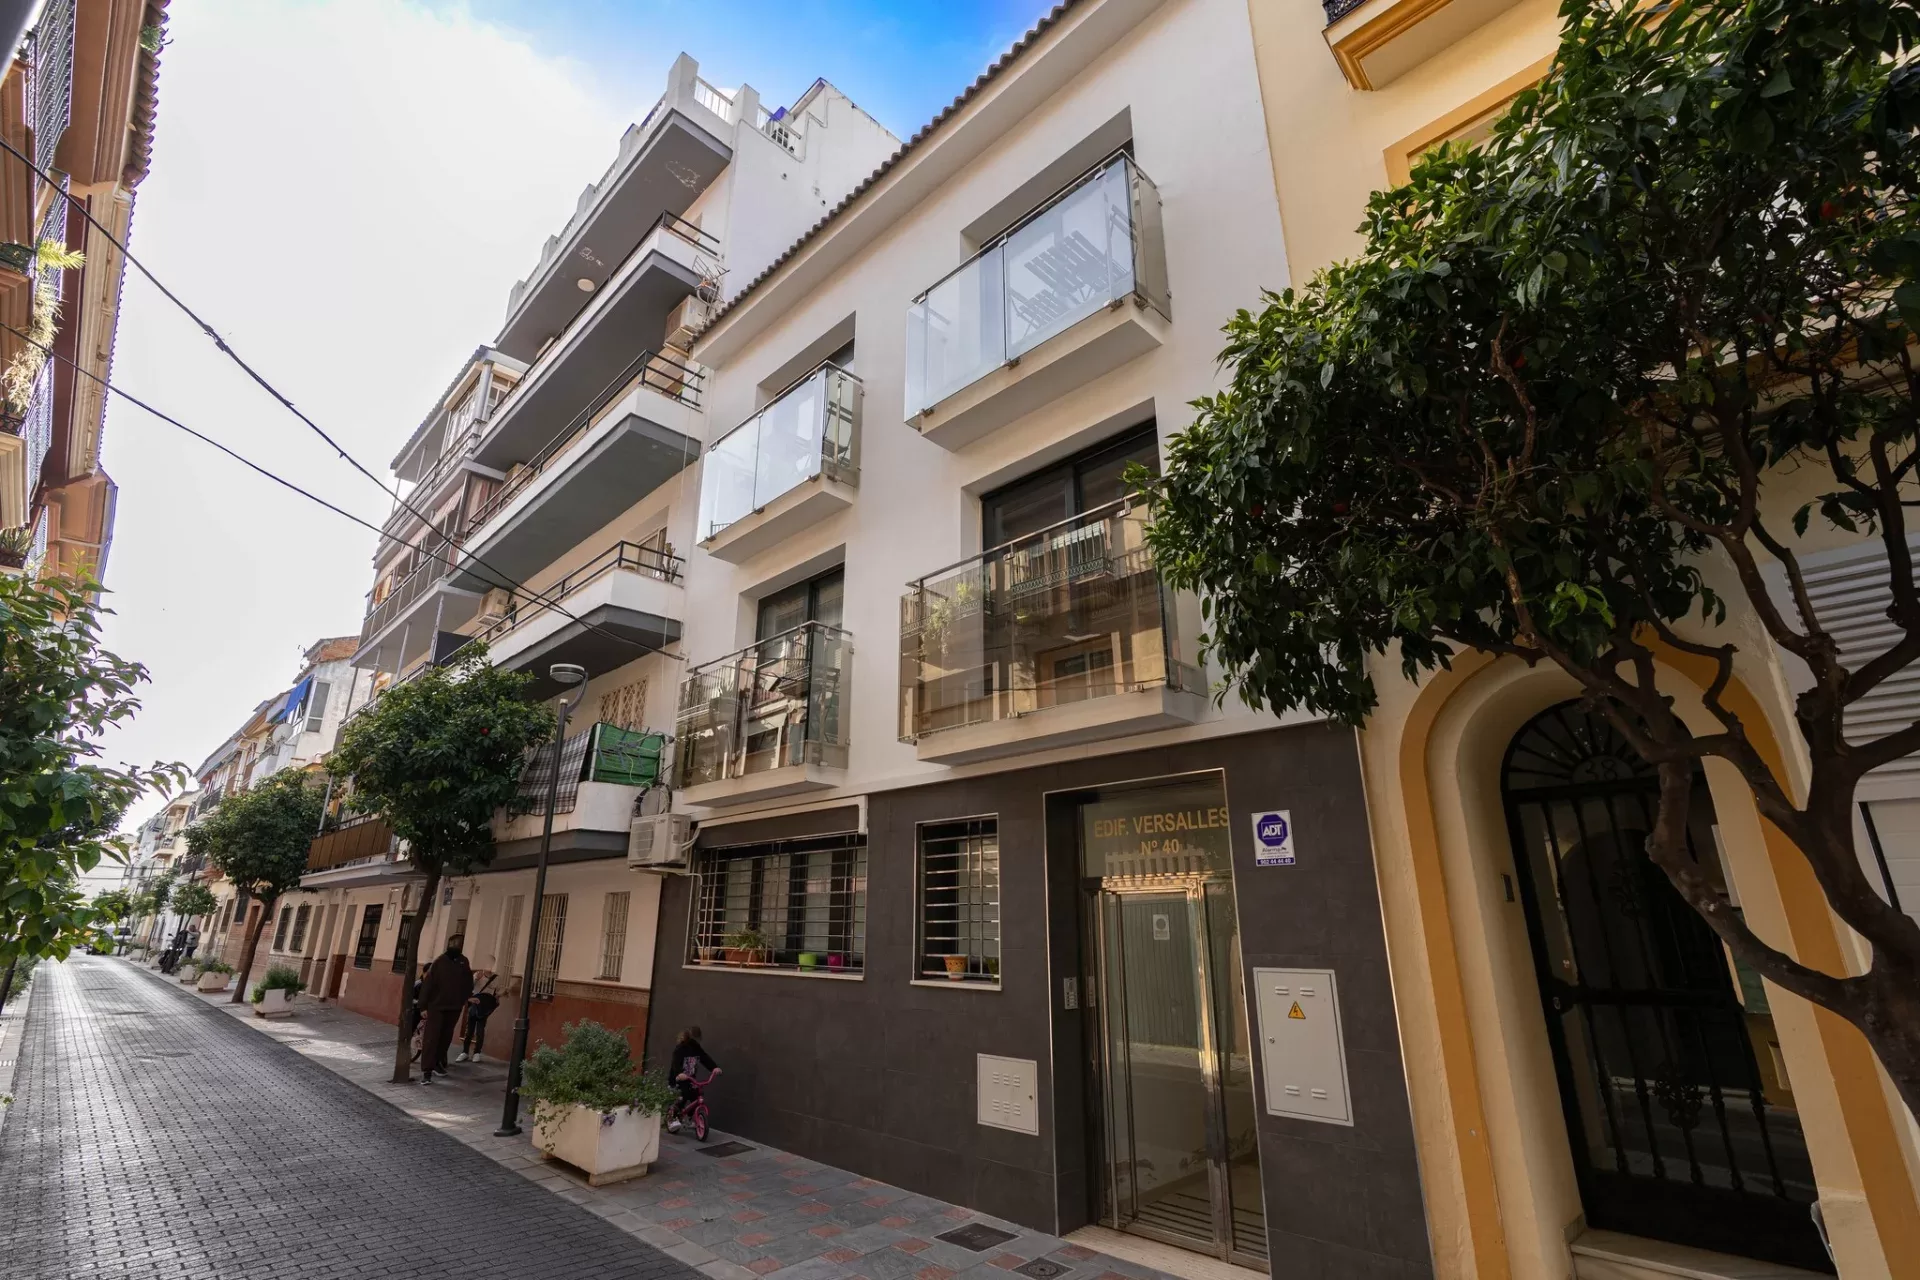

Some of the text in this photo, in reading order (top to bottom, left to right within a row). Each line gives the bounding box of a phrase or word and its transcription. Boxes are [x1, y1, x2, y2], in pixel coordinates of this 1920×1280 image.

[1094, 807, 1230, 838] EDIF. VERSALLES
[1263, 824, 1282, 837] ADT
[1141, 838, 1180, 856] Nº 40
